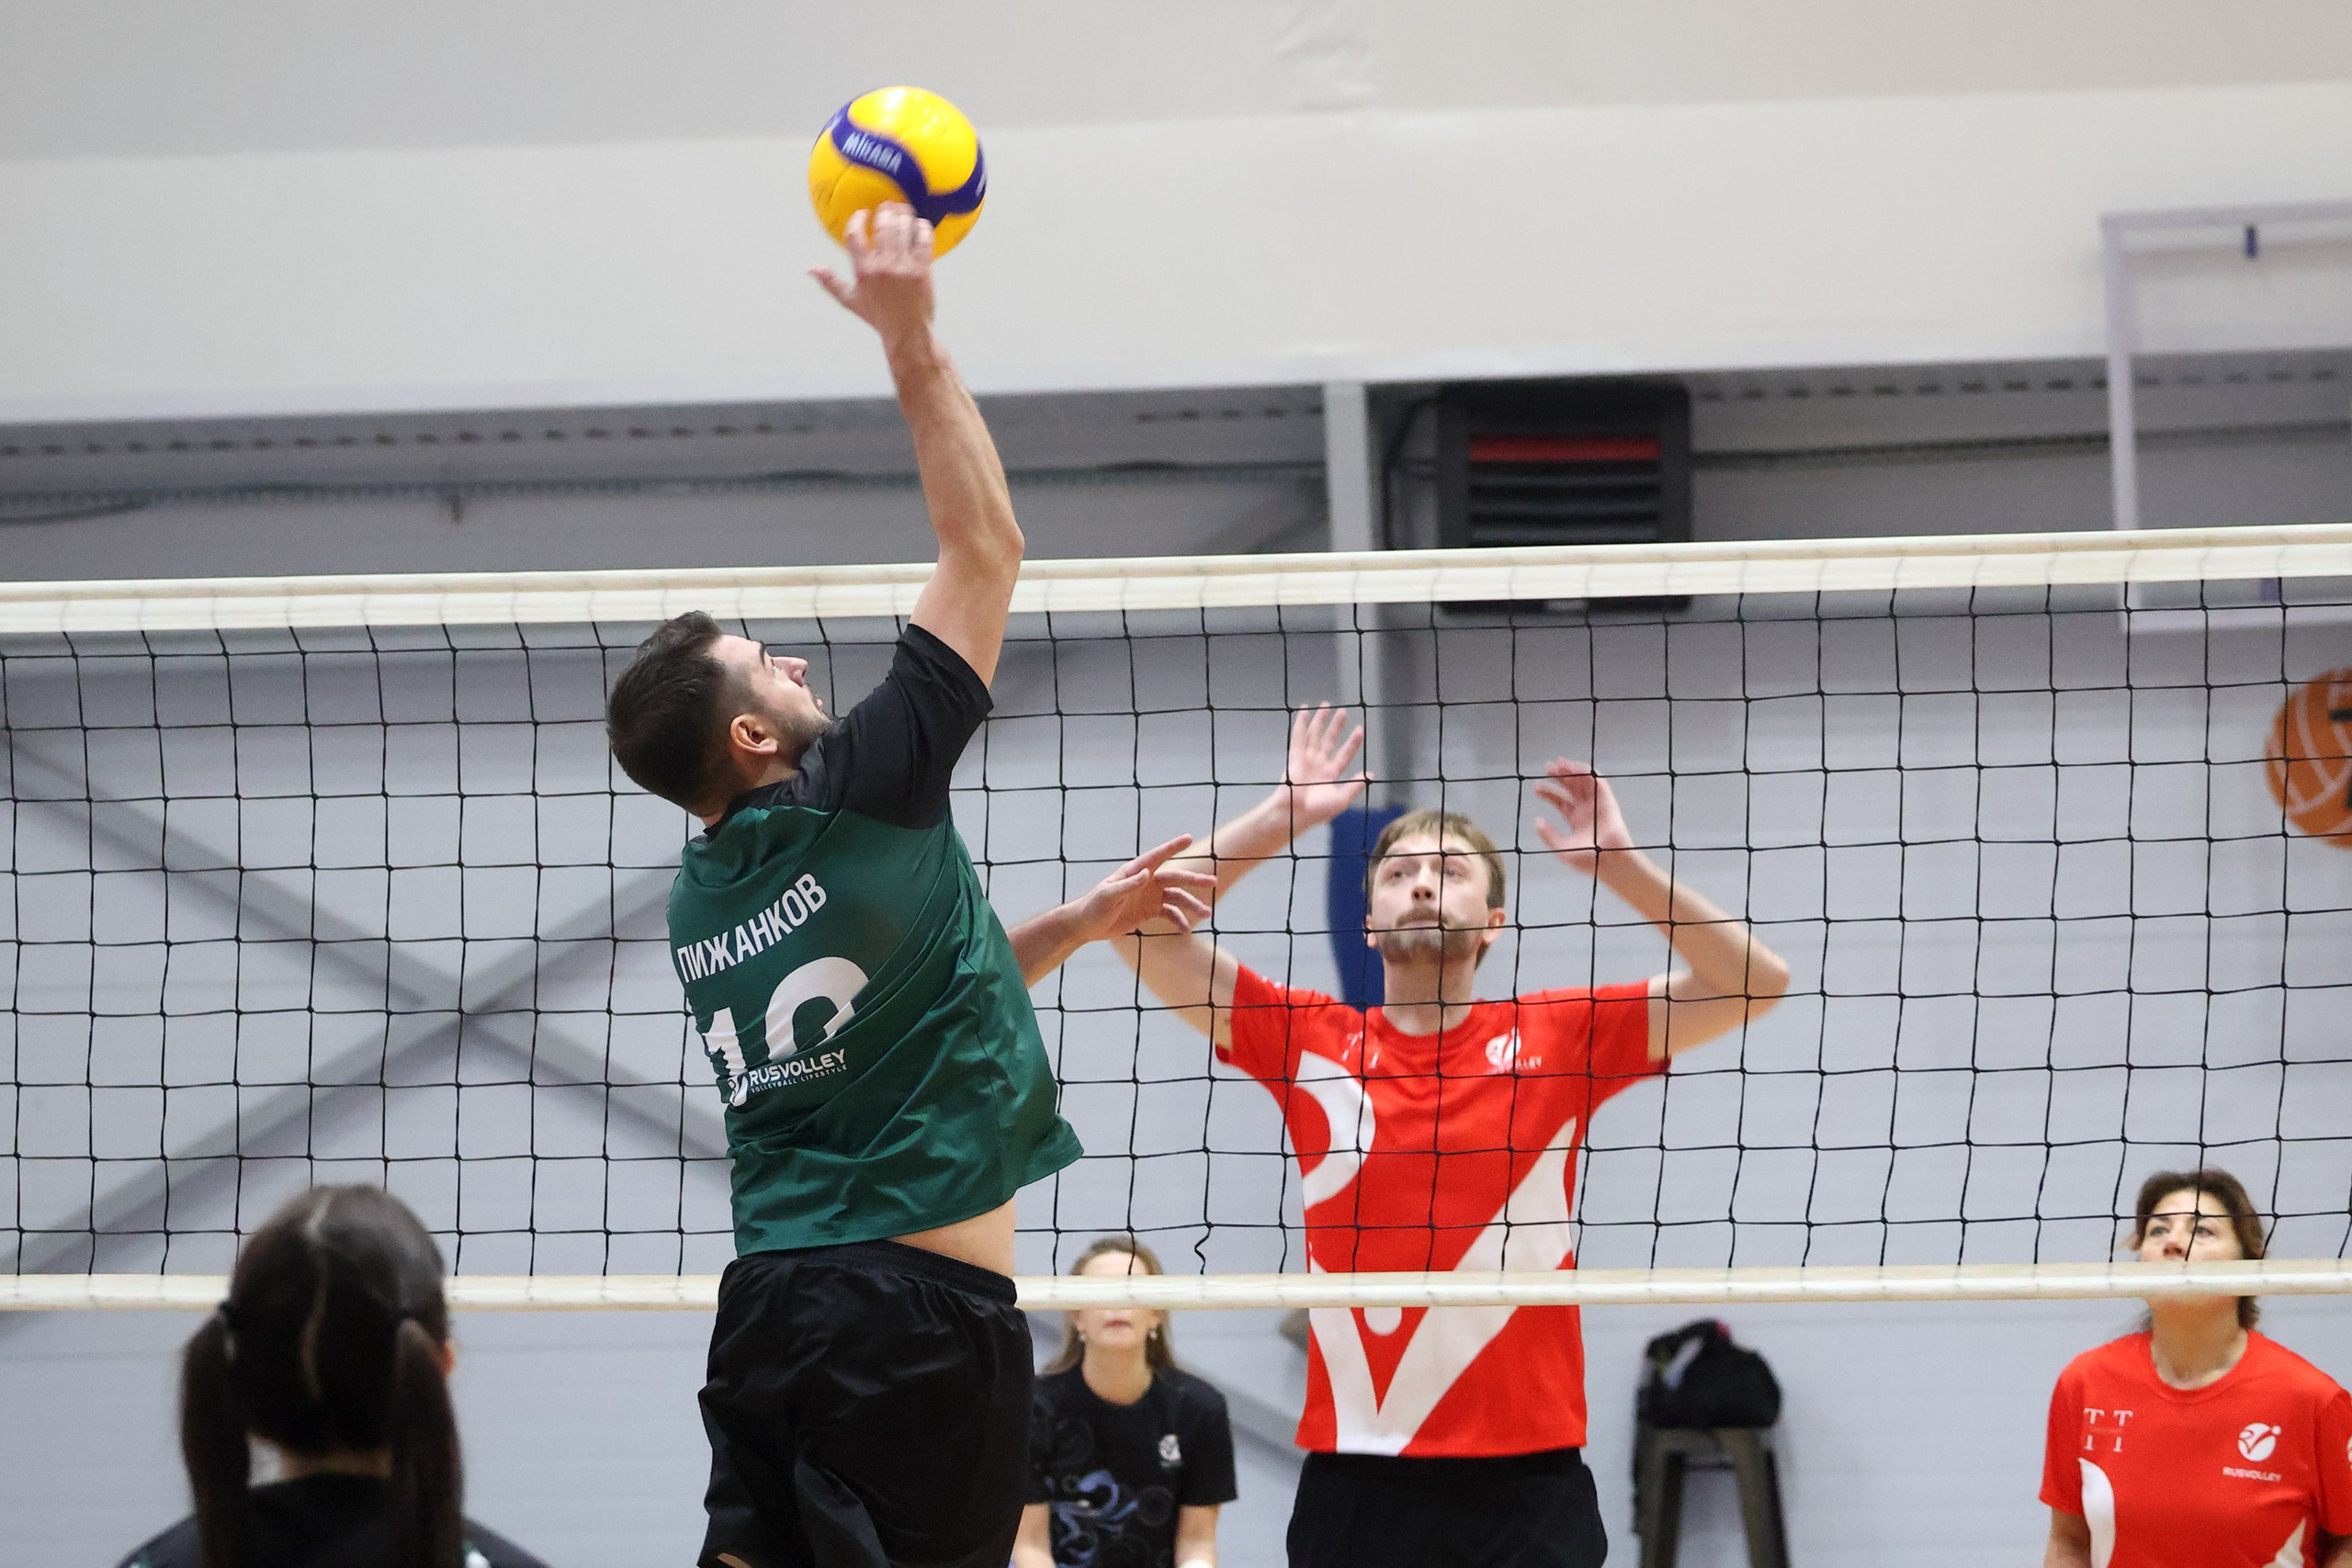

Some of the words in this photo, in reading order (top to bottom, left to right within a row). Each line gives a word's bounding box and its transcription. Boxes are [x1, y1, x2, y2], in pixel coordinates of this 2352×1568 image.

[676, 873, 827, 983] ПИЖАНКОВ
[749, 1048, 845, 1086] RUSVOLLEY
[751, 1077, 797, 1094] VOLLEYBALL
[800, 1064, 847, 1082] LIFESTYLE
